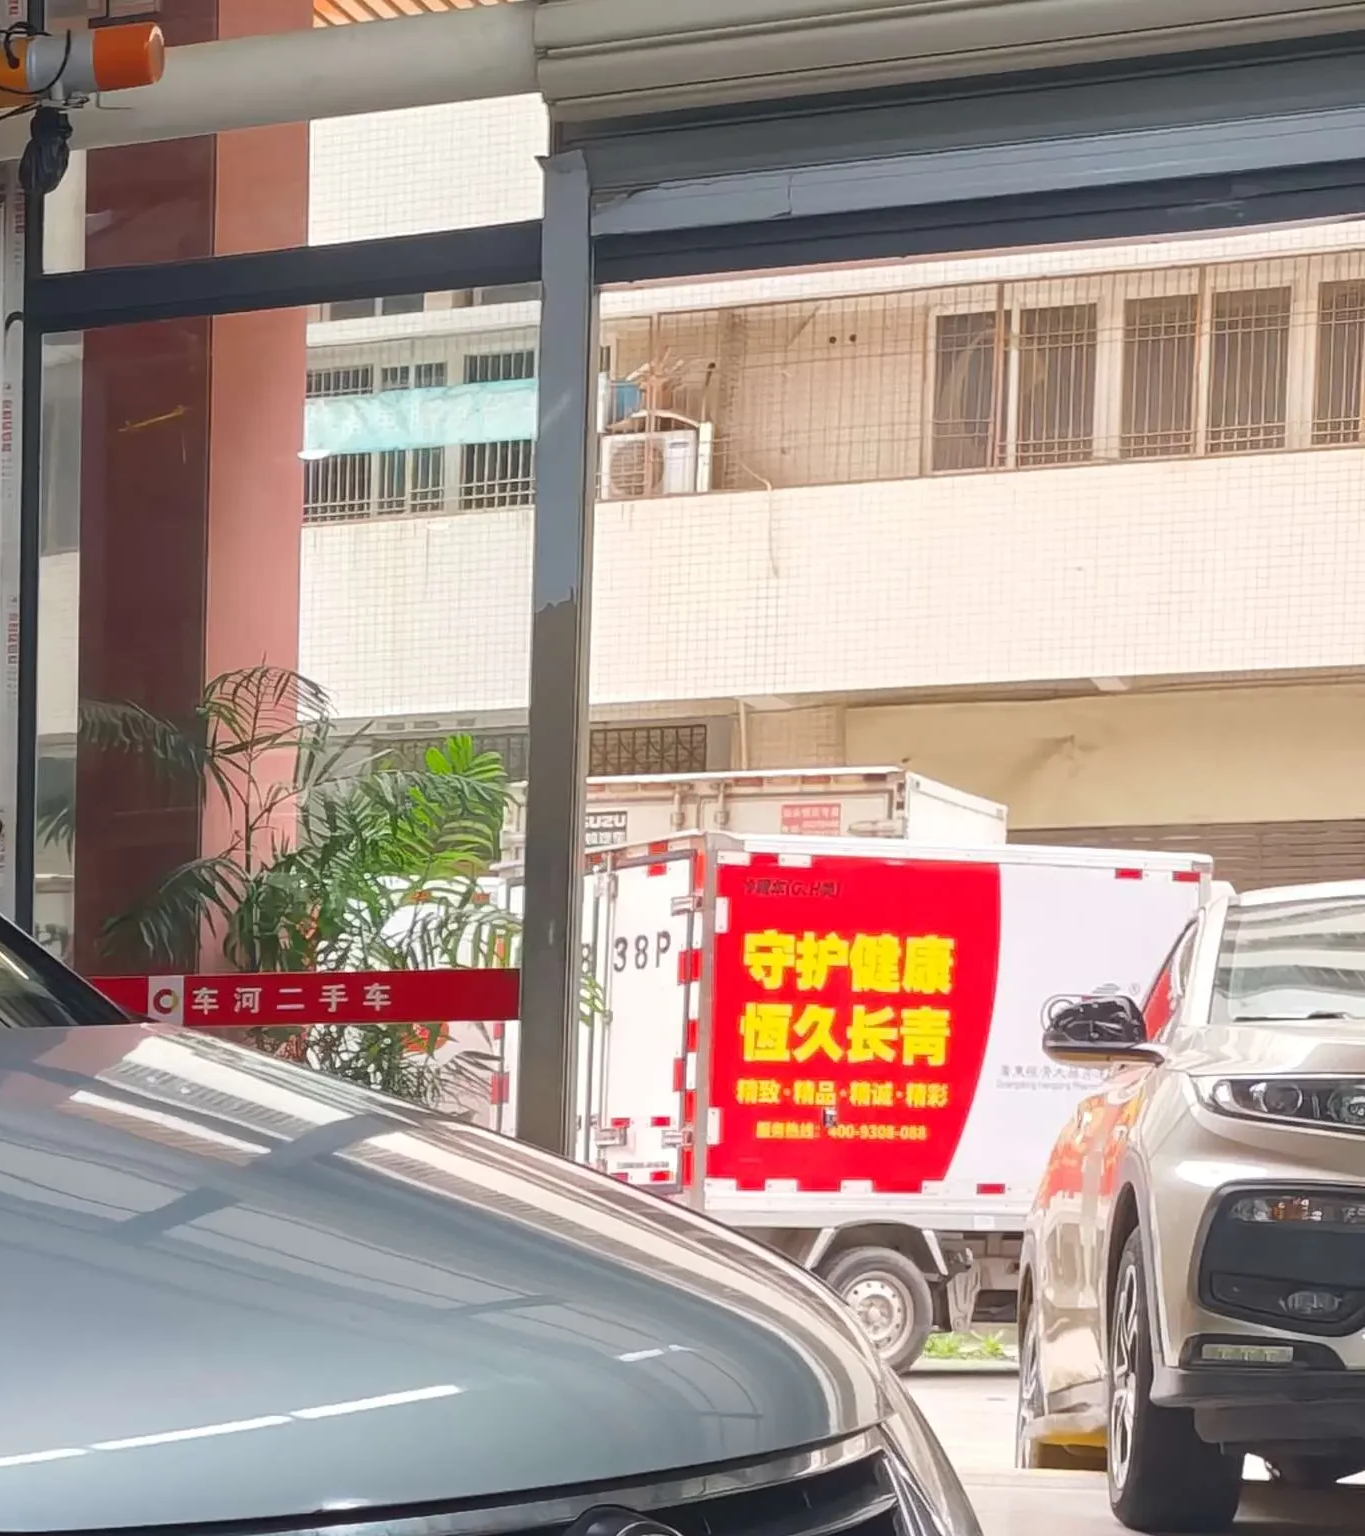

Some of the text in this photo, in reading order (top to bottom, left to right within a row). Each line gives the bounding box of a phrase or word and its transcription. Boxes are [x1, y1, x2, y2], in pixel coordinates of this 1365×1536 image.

[743, 928, 955, 995] 守护健康
[191, 982, 393, 1015] 车河二手车
